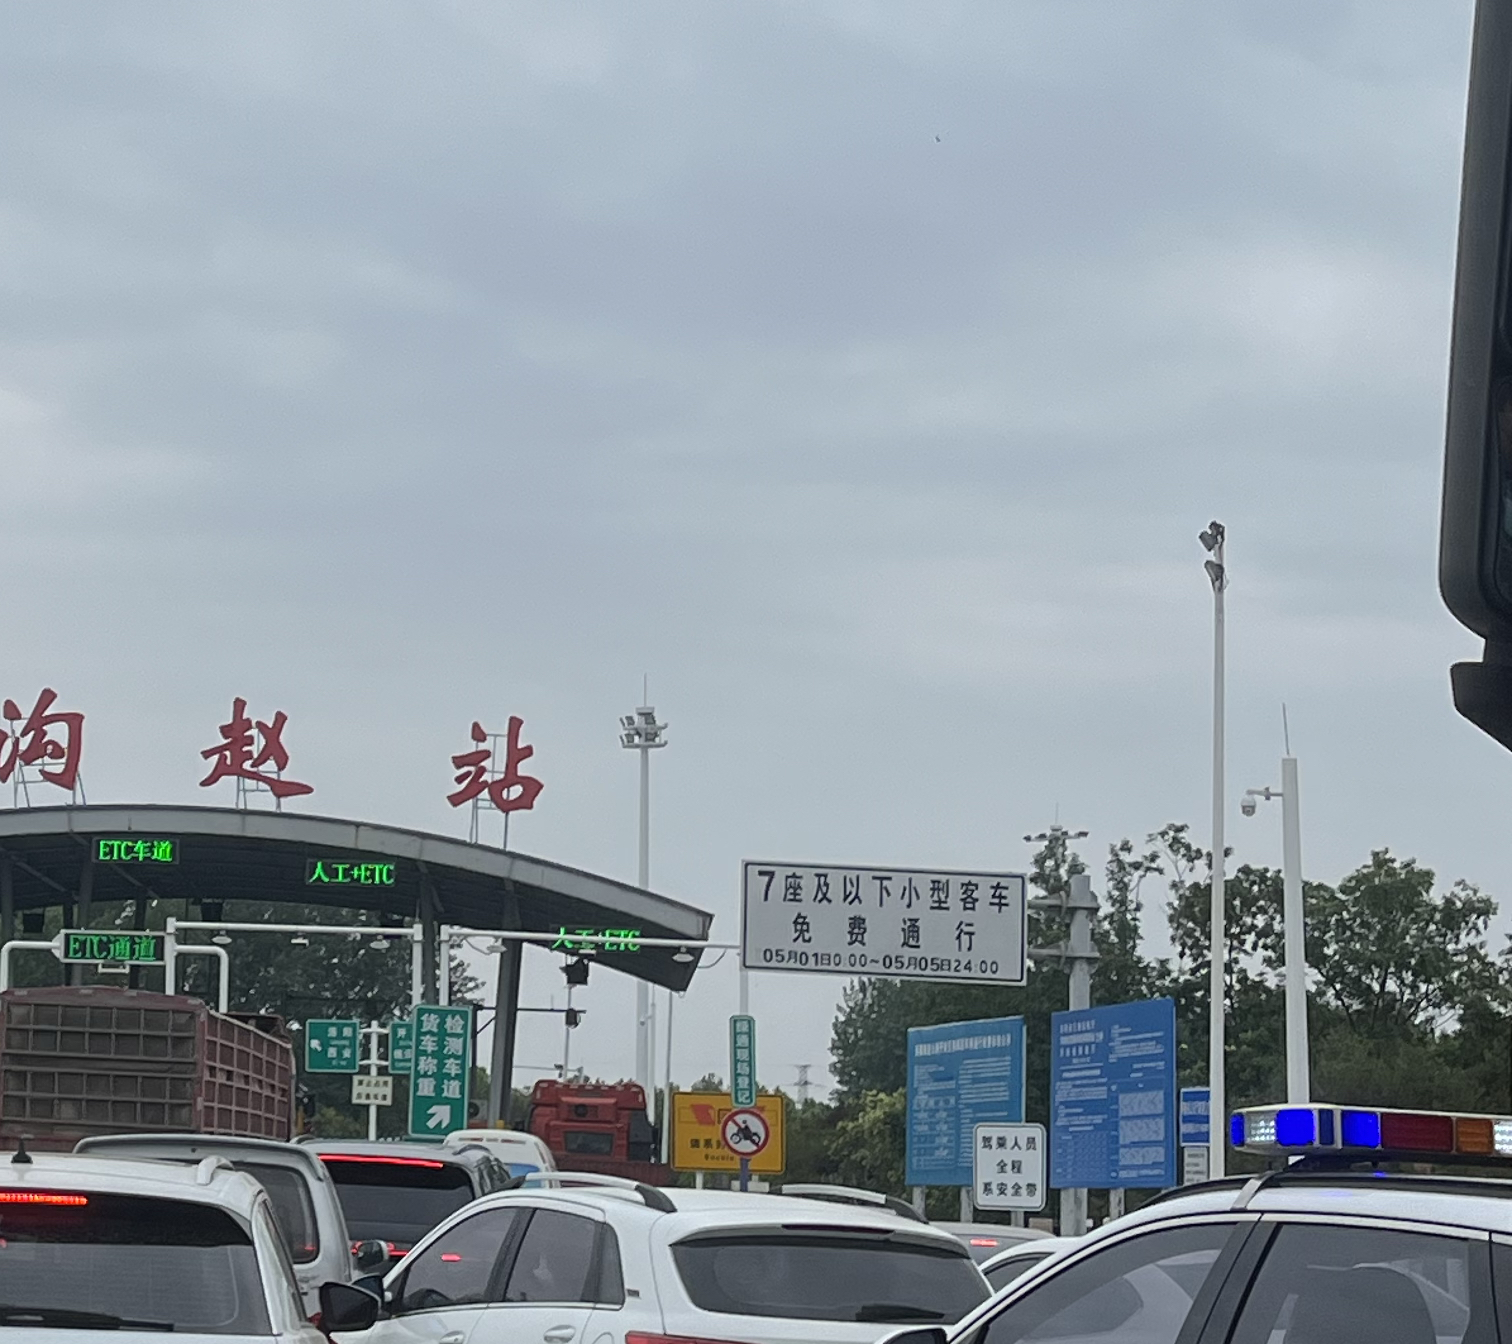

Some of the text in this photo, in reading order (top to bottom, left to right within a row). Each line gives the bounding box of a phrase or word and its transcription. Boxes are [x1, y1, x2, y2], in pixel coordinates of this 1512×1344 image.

[98, 840, 173, 862] ETC车道
[308, 861, 395, 885] 人工+ETC
[758, 870, 1010, 913] 7座及以下小型客车
[792, 912, 976, 952] 免费通行
[68, 935, 156, 961] ETC通道
[416, 1013, 440, 1097] 货车称重
[442, 1014, 465, 1099] 检测车道
[981, 1136, 1037, 1151] 驾乘人员
[996, 1160, 1023, 1174] 全程
[982, 1182, 1037, 1197] 系安全带
